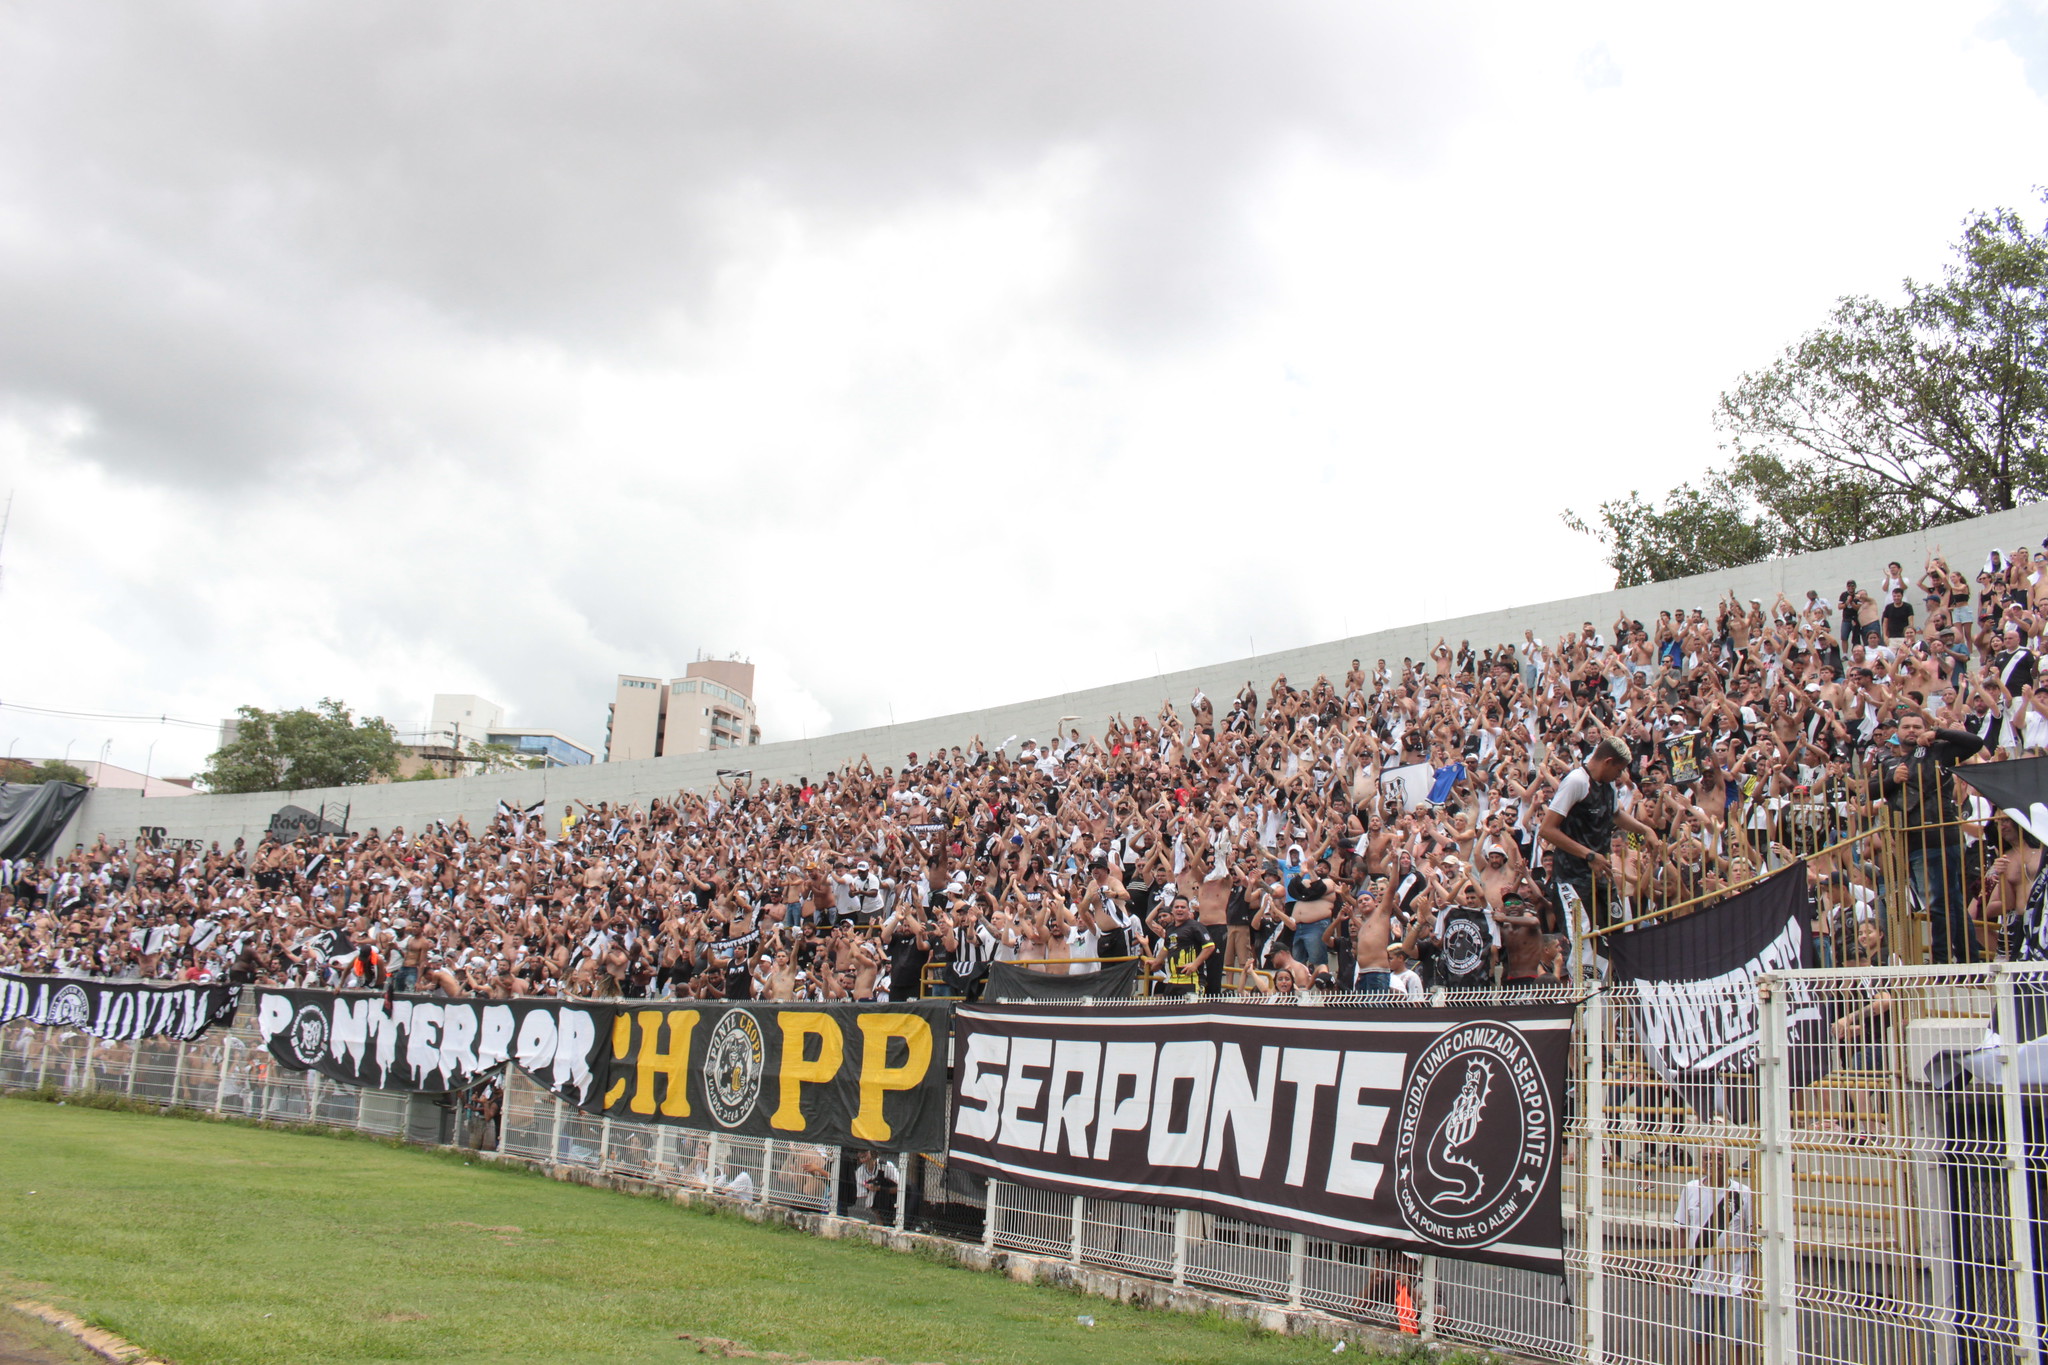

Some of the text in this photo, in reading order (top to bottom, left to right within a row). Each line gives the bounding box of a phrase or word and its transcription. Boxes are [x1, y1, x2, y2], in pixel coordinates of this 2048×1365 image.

[711, 1014, 760, 1063] PONTE CHOPP
[955, 1033, 1407, 1200] SERPONTE
[1399, 1028, 1546, 1168] TORCIDA UNIFORMIZADA SERPONTE
[1411, 1211, 1420, 1224] A
[1419, 1216, 1455, 1239] PONTE
[1456, 1223, 1478, 1239] ATÉ
[1478, 1221, 1488, 1235] O
